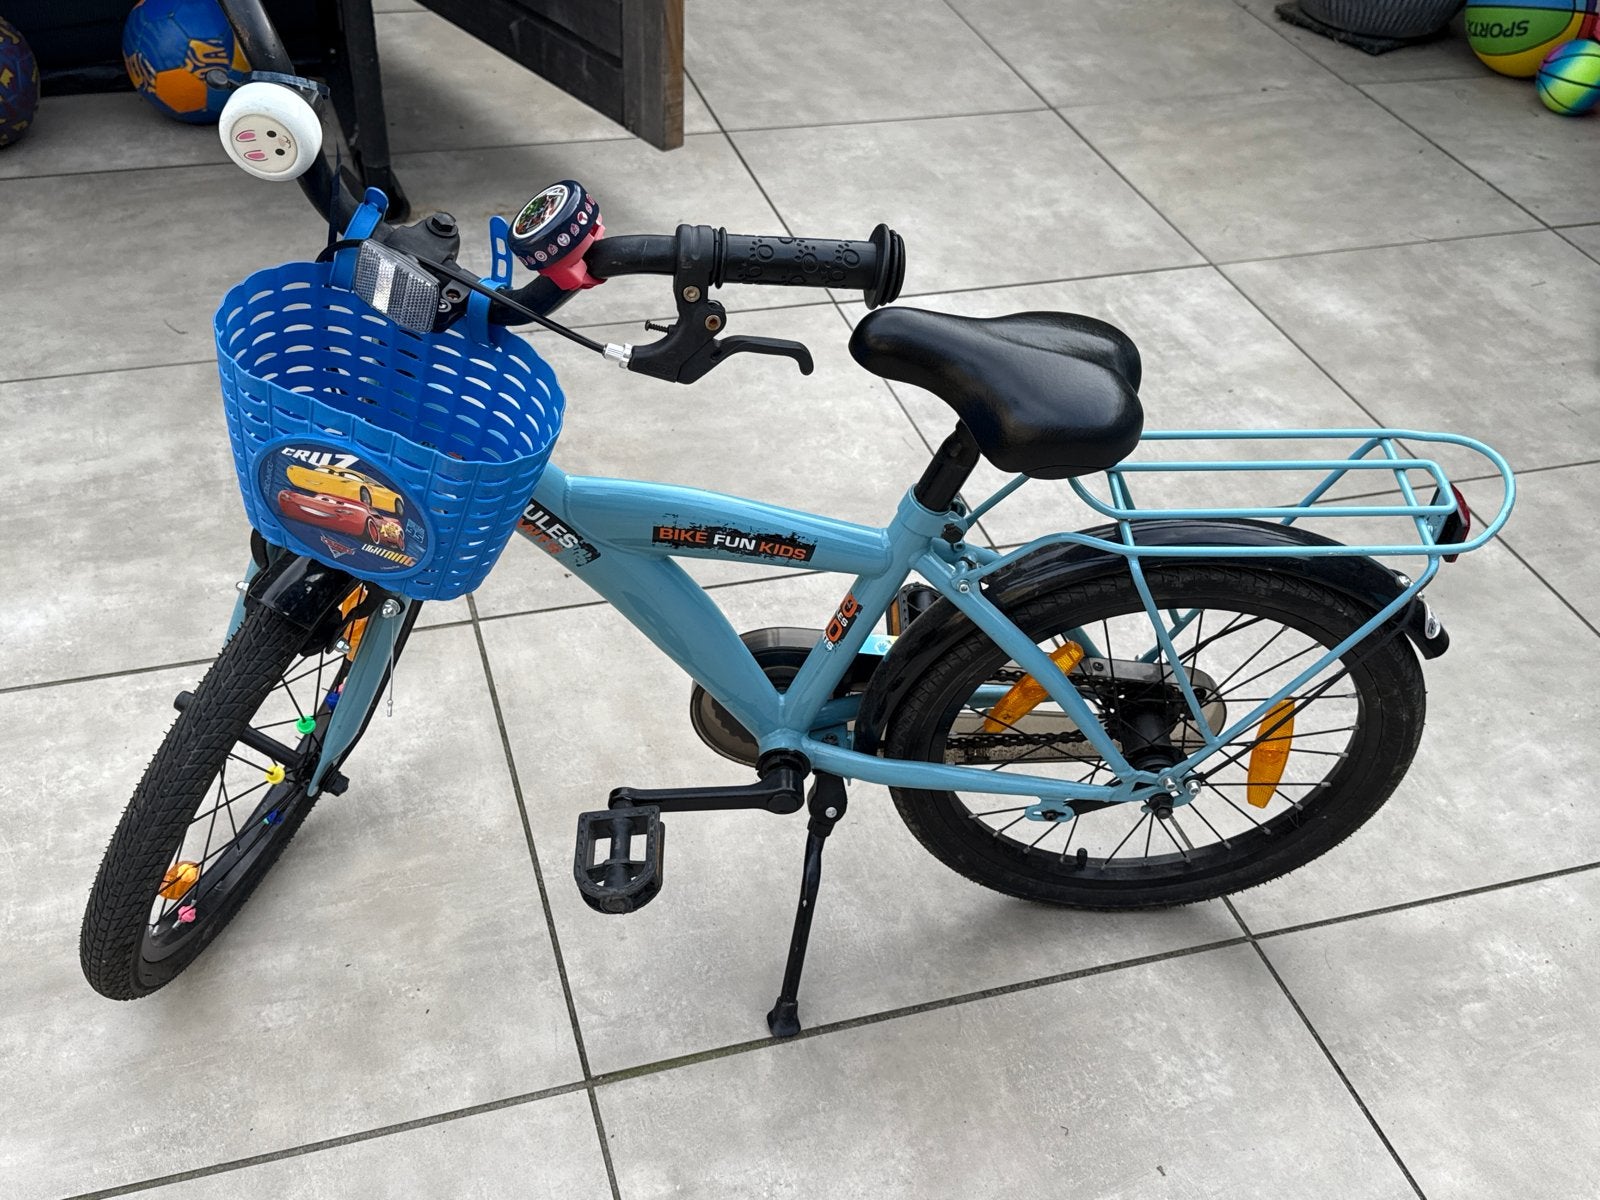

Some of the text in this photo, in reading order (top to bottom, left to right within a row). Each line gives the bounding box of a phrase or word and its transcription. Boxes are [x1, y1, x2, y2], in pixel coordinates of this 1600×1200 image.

[659, 527, 807, 560] BIKE FUN KIDS
